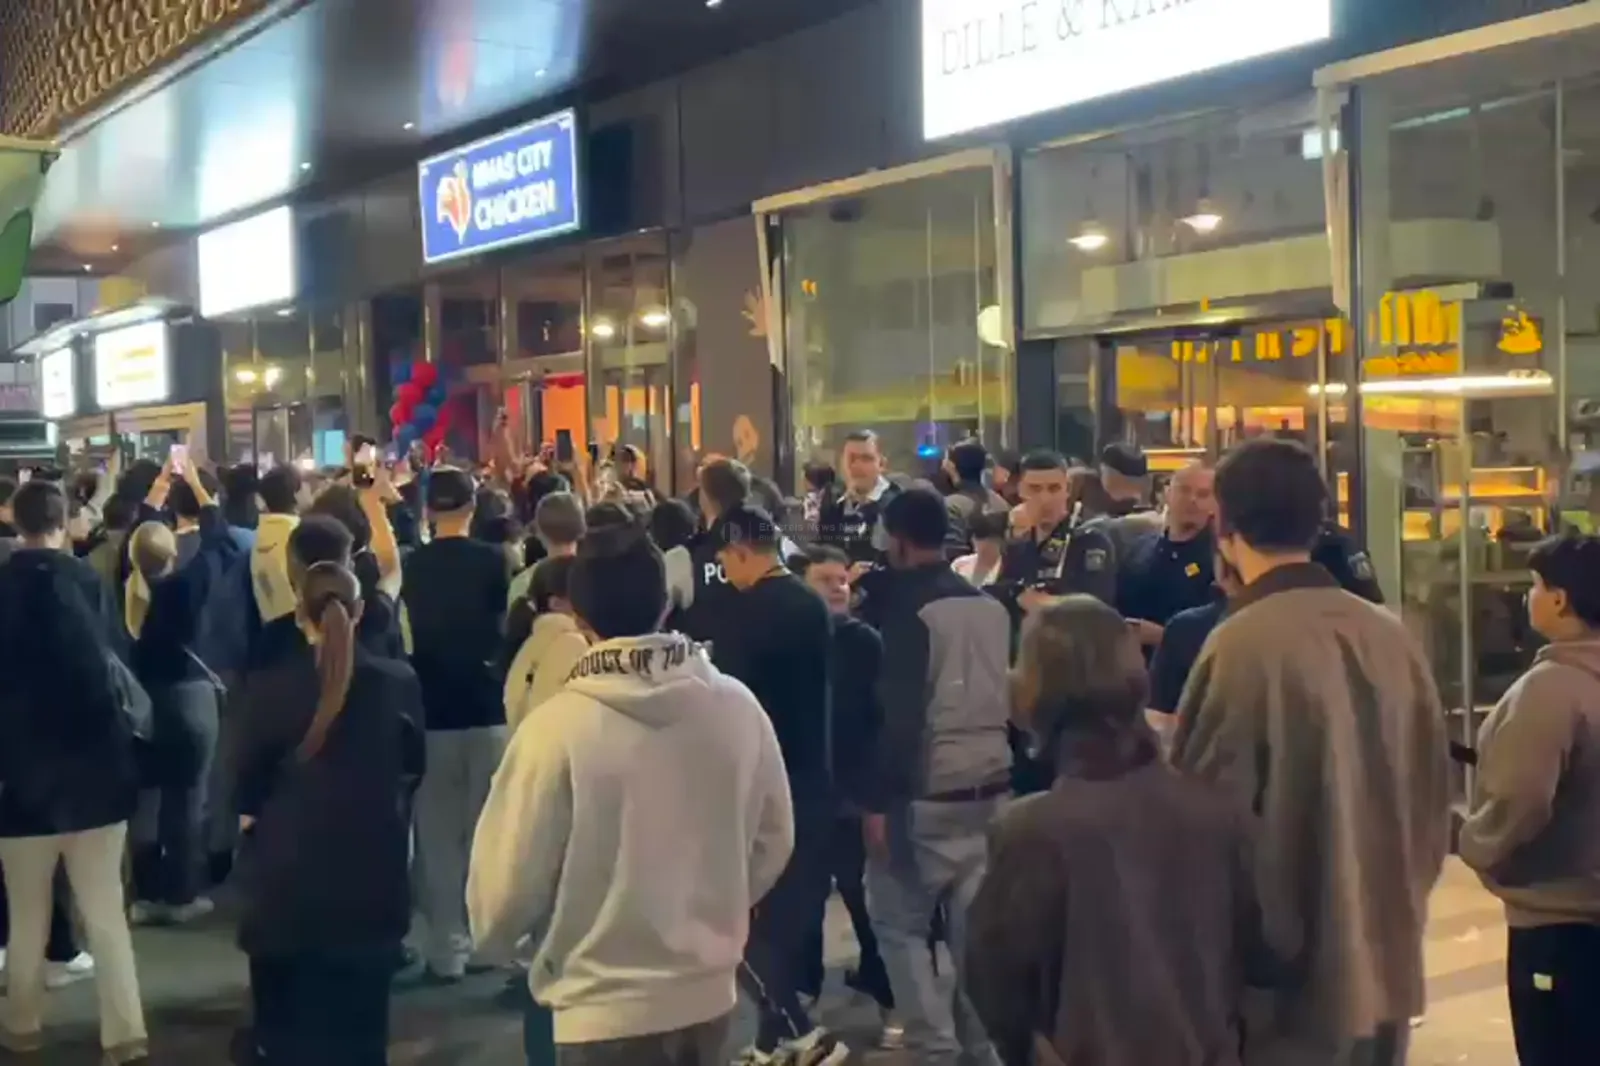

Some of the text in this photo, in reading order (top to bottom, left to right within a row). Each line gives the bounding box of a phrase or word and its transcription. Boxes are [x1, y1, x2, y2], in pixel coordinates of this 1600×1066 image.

[941, 2, 1039, 76] DILLE
[1056, 0, 1084, 42] &
[517, 139, 553, 177] CITY
[474, 178, 556, 231] CHICKEN
